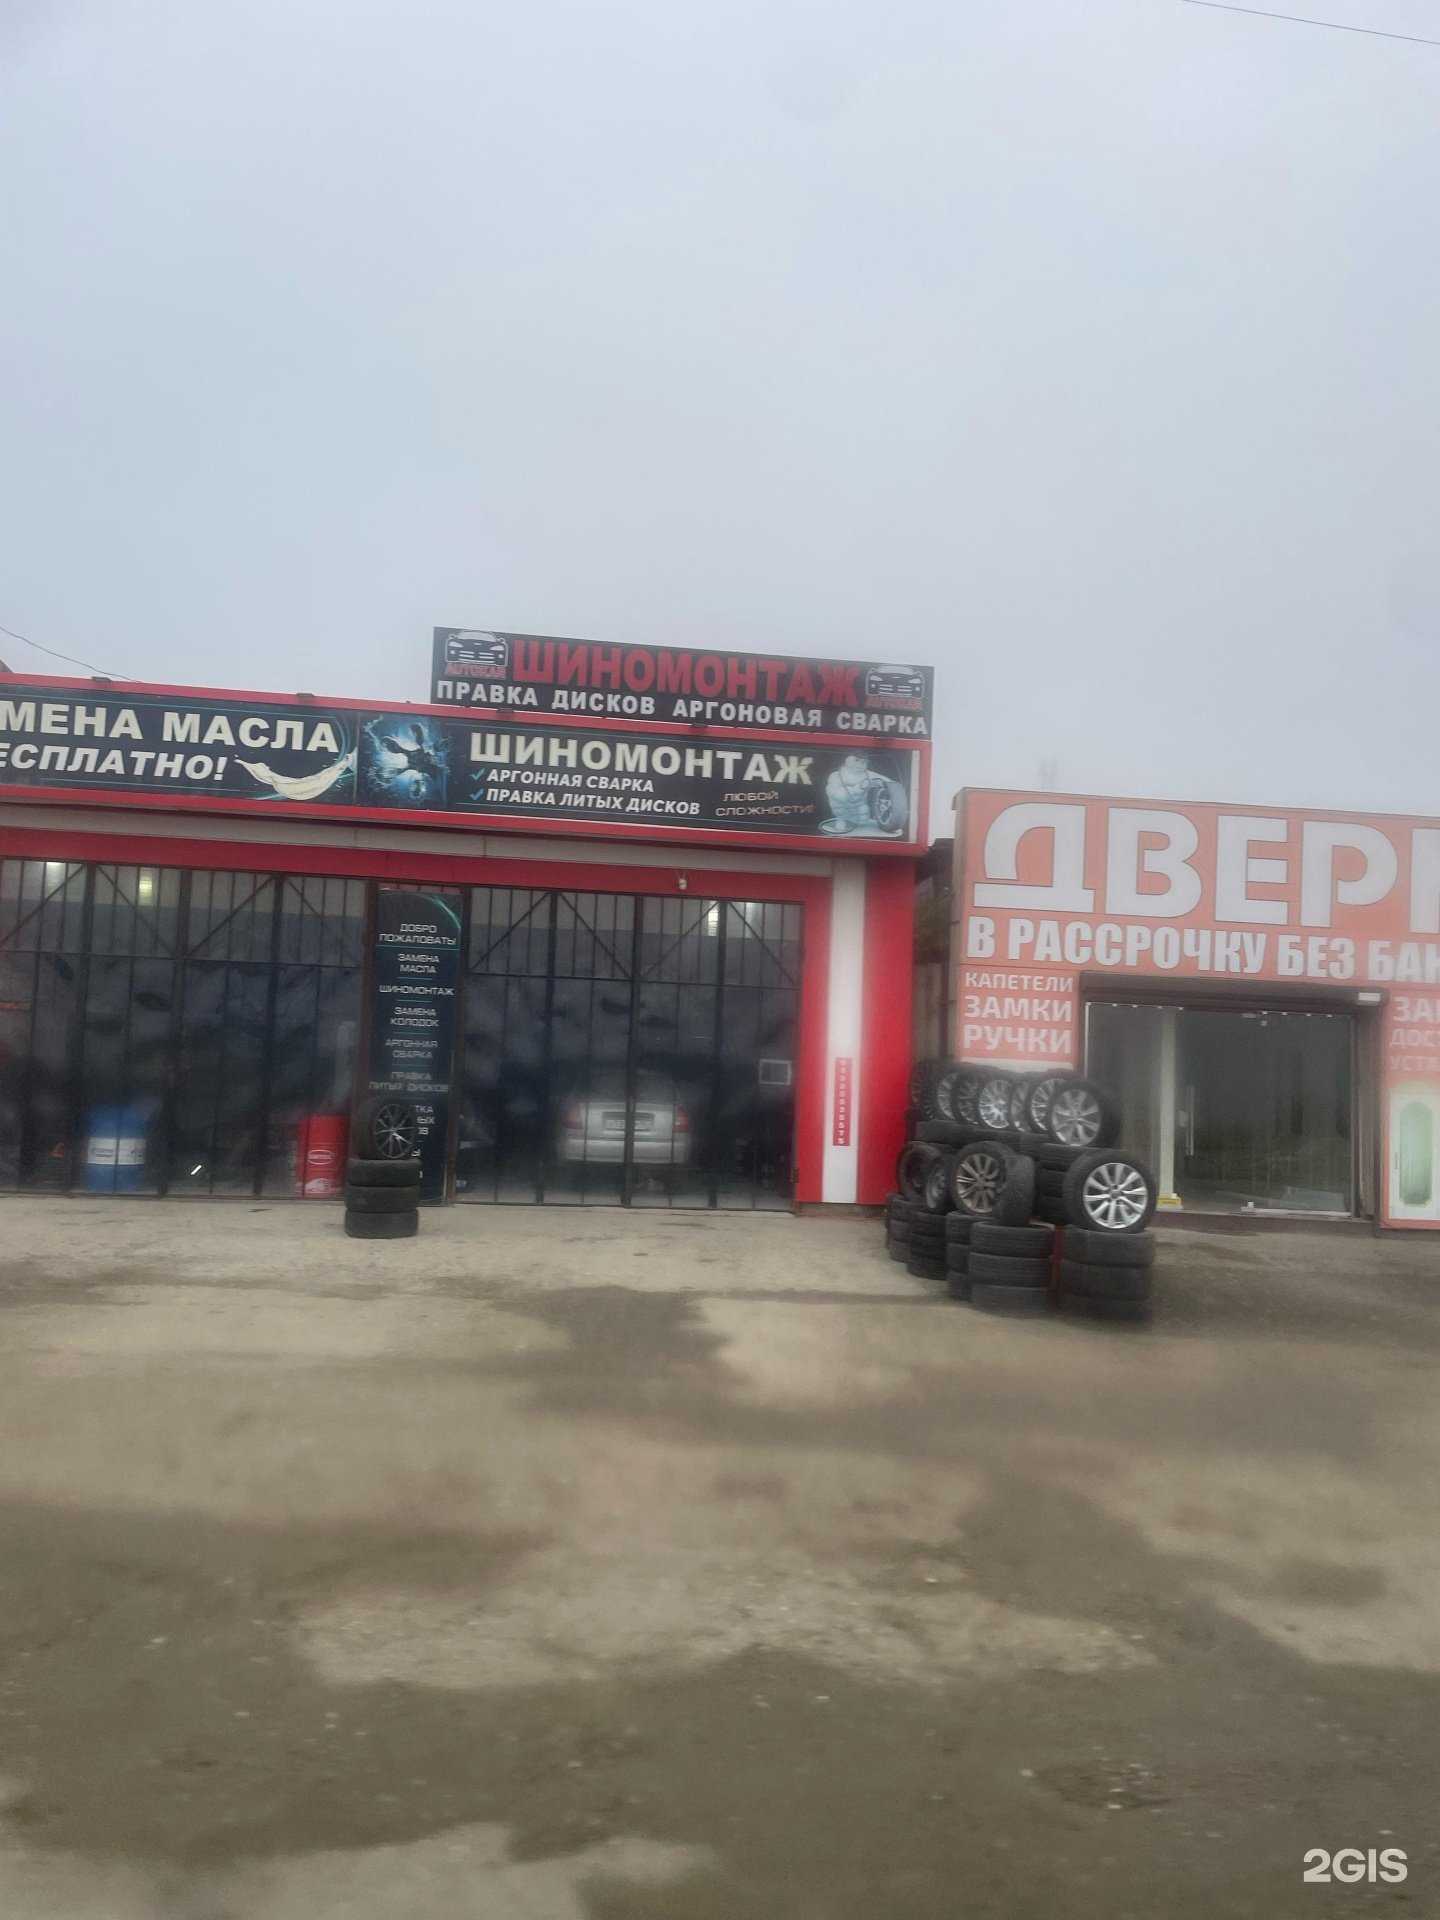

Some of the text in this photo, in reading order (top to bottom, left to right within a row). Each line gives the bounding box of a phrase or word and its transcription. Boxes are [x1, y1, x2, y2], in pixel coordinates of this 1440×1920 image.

[512, 638, 863, 707] ШИНОМОНТАЖ
[437, 680, 929, 735] ПРАВКА ДИСКОВ АРГОНОВАЯ СВАРКА
[162, 711, 339, 753] МАСЛА
[470, 732, 814, 786] ШИНОМОНТАЖ
[487, 768, 654, 793] АРГОННАЯ СВАРКА
[486, 788, 701, 816] ПРАВКА ЛИТЫХ ДИСКОВ
[722, 790, 779, 802] ЛЮБОЙ
[400, 923, 438, 934] ДОБРО
[397, 953, 440, 963] ЗАМЕНА
[967, 916, 996, 958] В
[1008, 917, 1268, 975] РАССРОЧКУ
[1277, 933, 1355, 980] БЕЗ
[399, 964, 437, 974] МАСЛА
[965, 972, 1074, 993] КАПЕТЕЛИ
[378, 985, 456, 996] ШИНОМОНТАЖ
[393, 1006, 437, 1017] ЗАМЕНА
[964, 994, 1073, 1023] ЗАМКИ
[1392, 996, 1440, 1025] ЗА
[963, 1024, 1072, 1055] РУЧКИ
